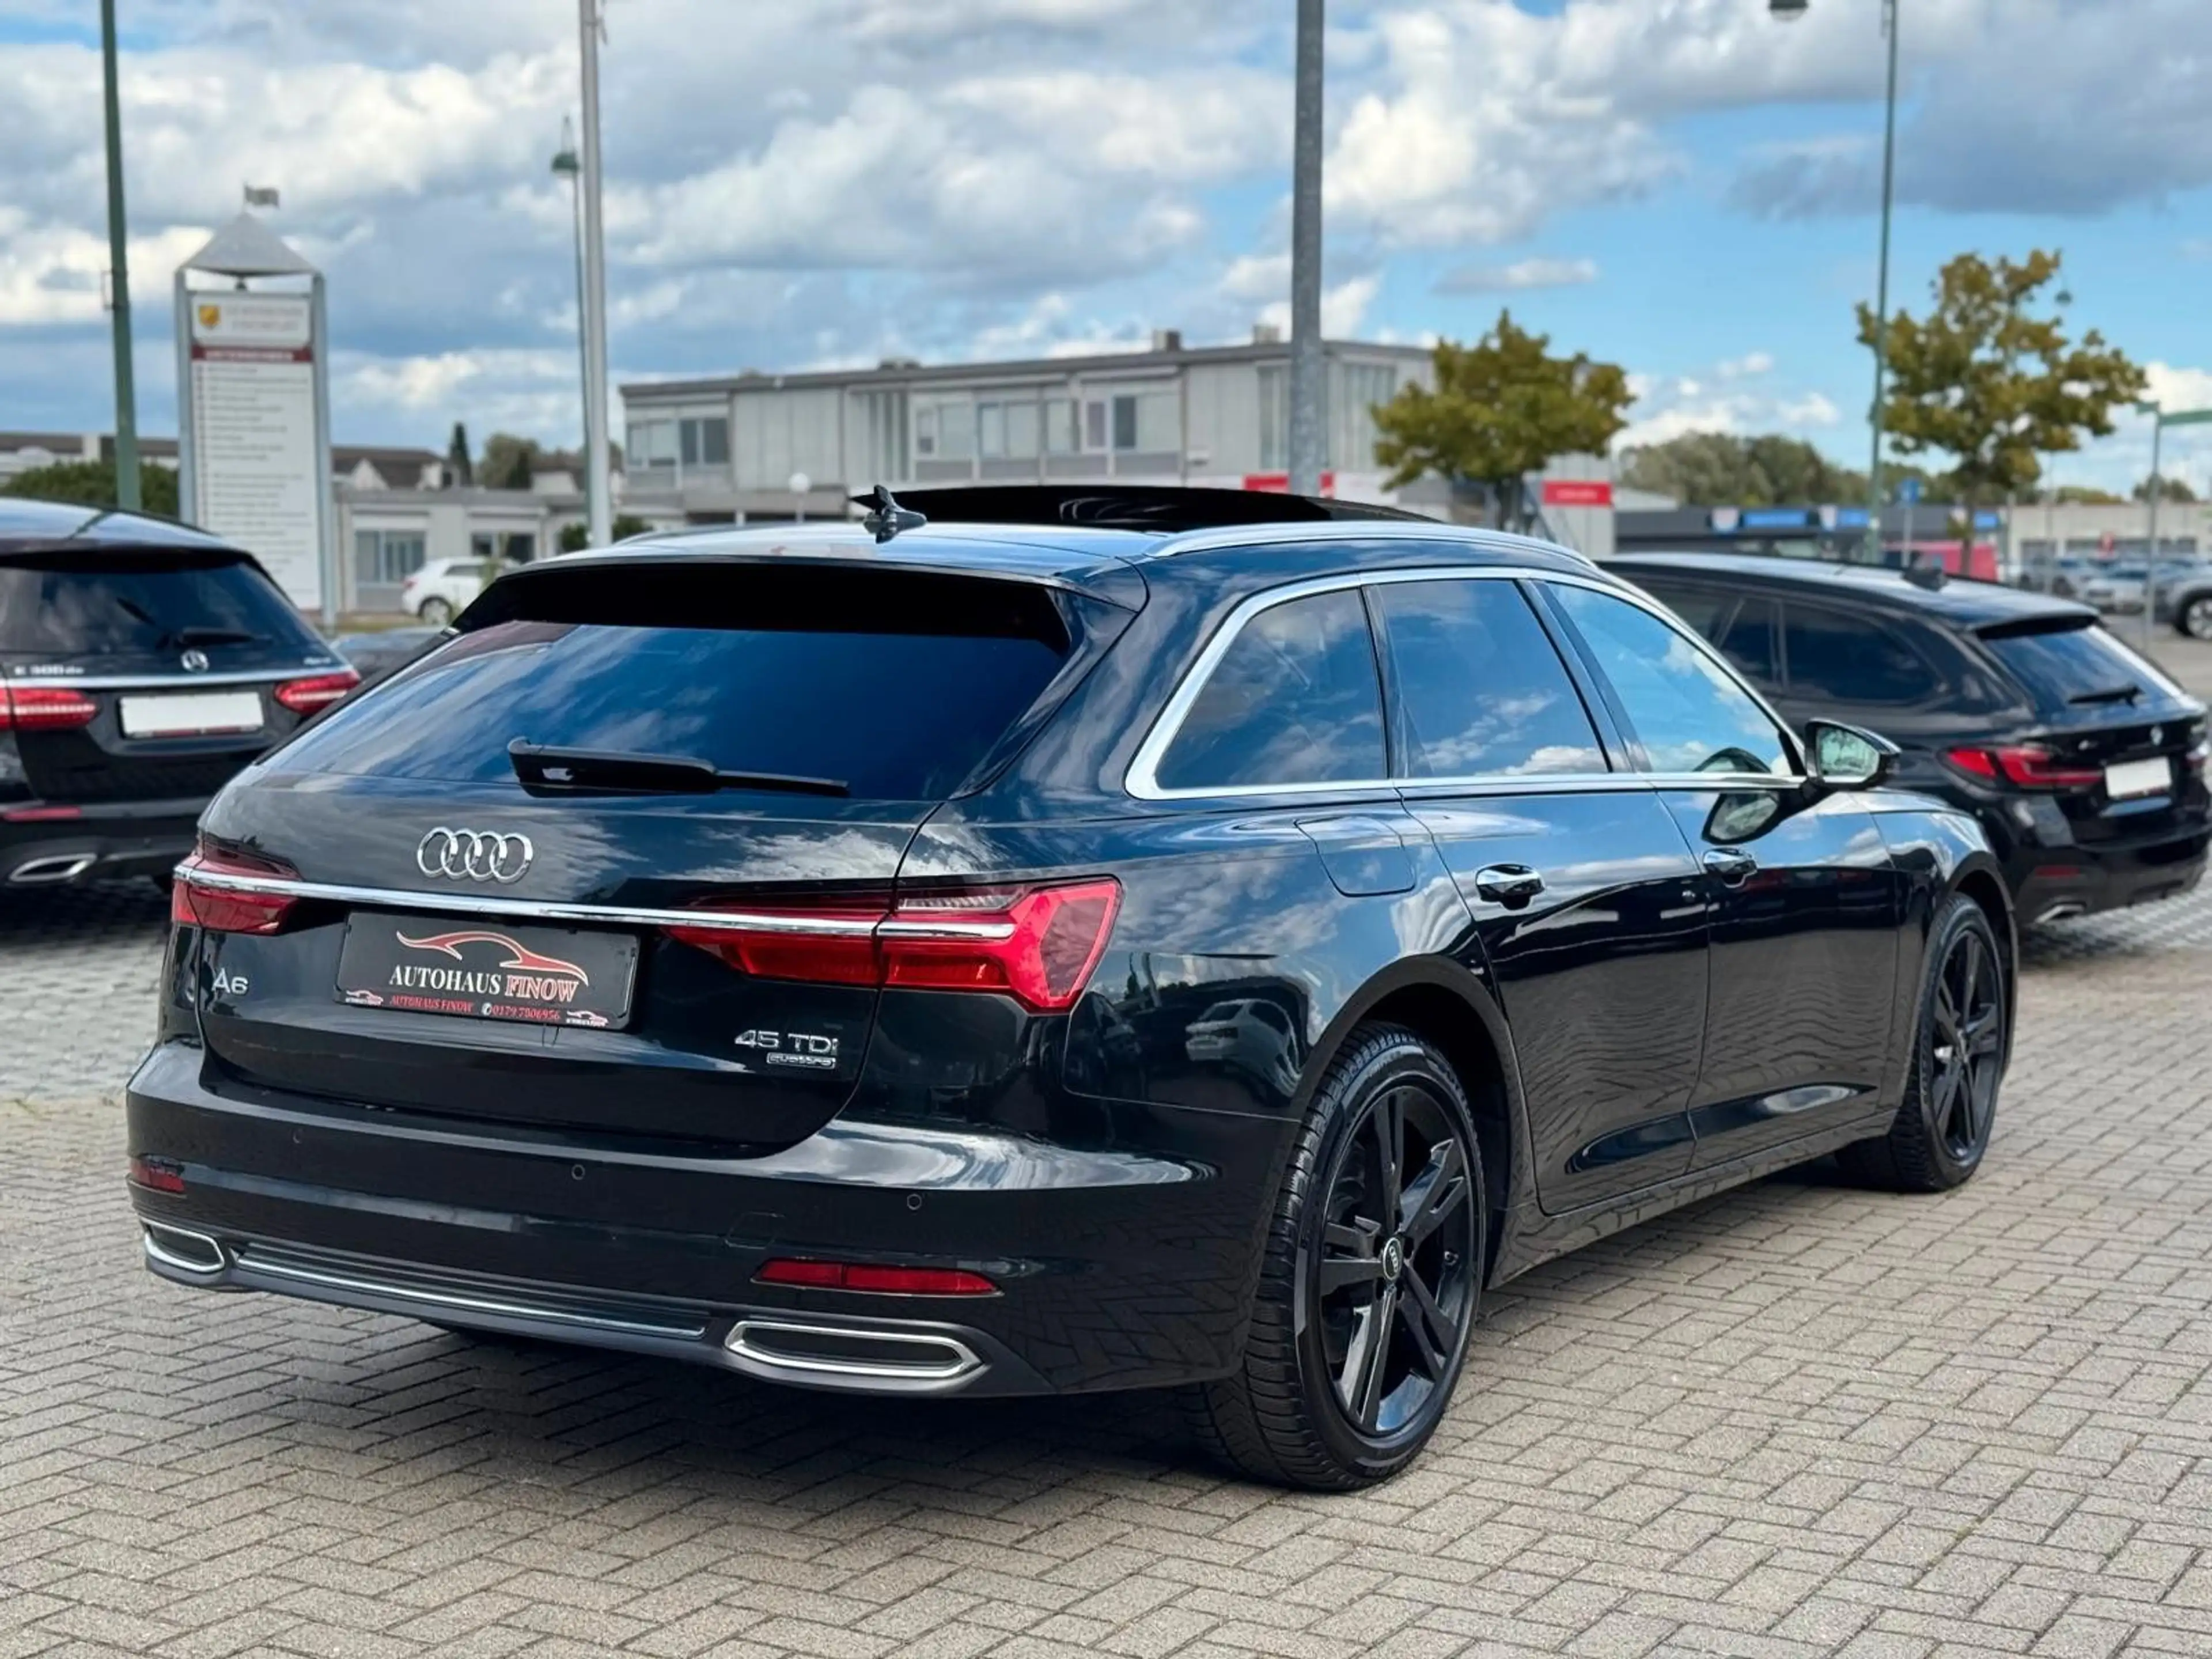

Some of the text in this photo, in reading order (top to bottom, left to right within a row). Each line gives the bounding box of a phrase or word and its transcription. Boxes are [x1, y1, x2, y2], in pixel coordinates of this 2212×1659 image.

[211, 968, 248, 994] A6
[389, 964, 579, 1002] AUTOHAUS FINOW
[735, 1029, 779, 1048] 45
